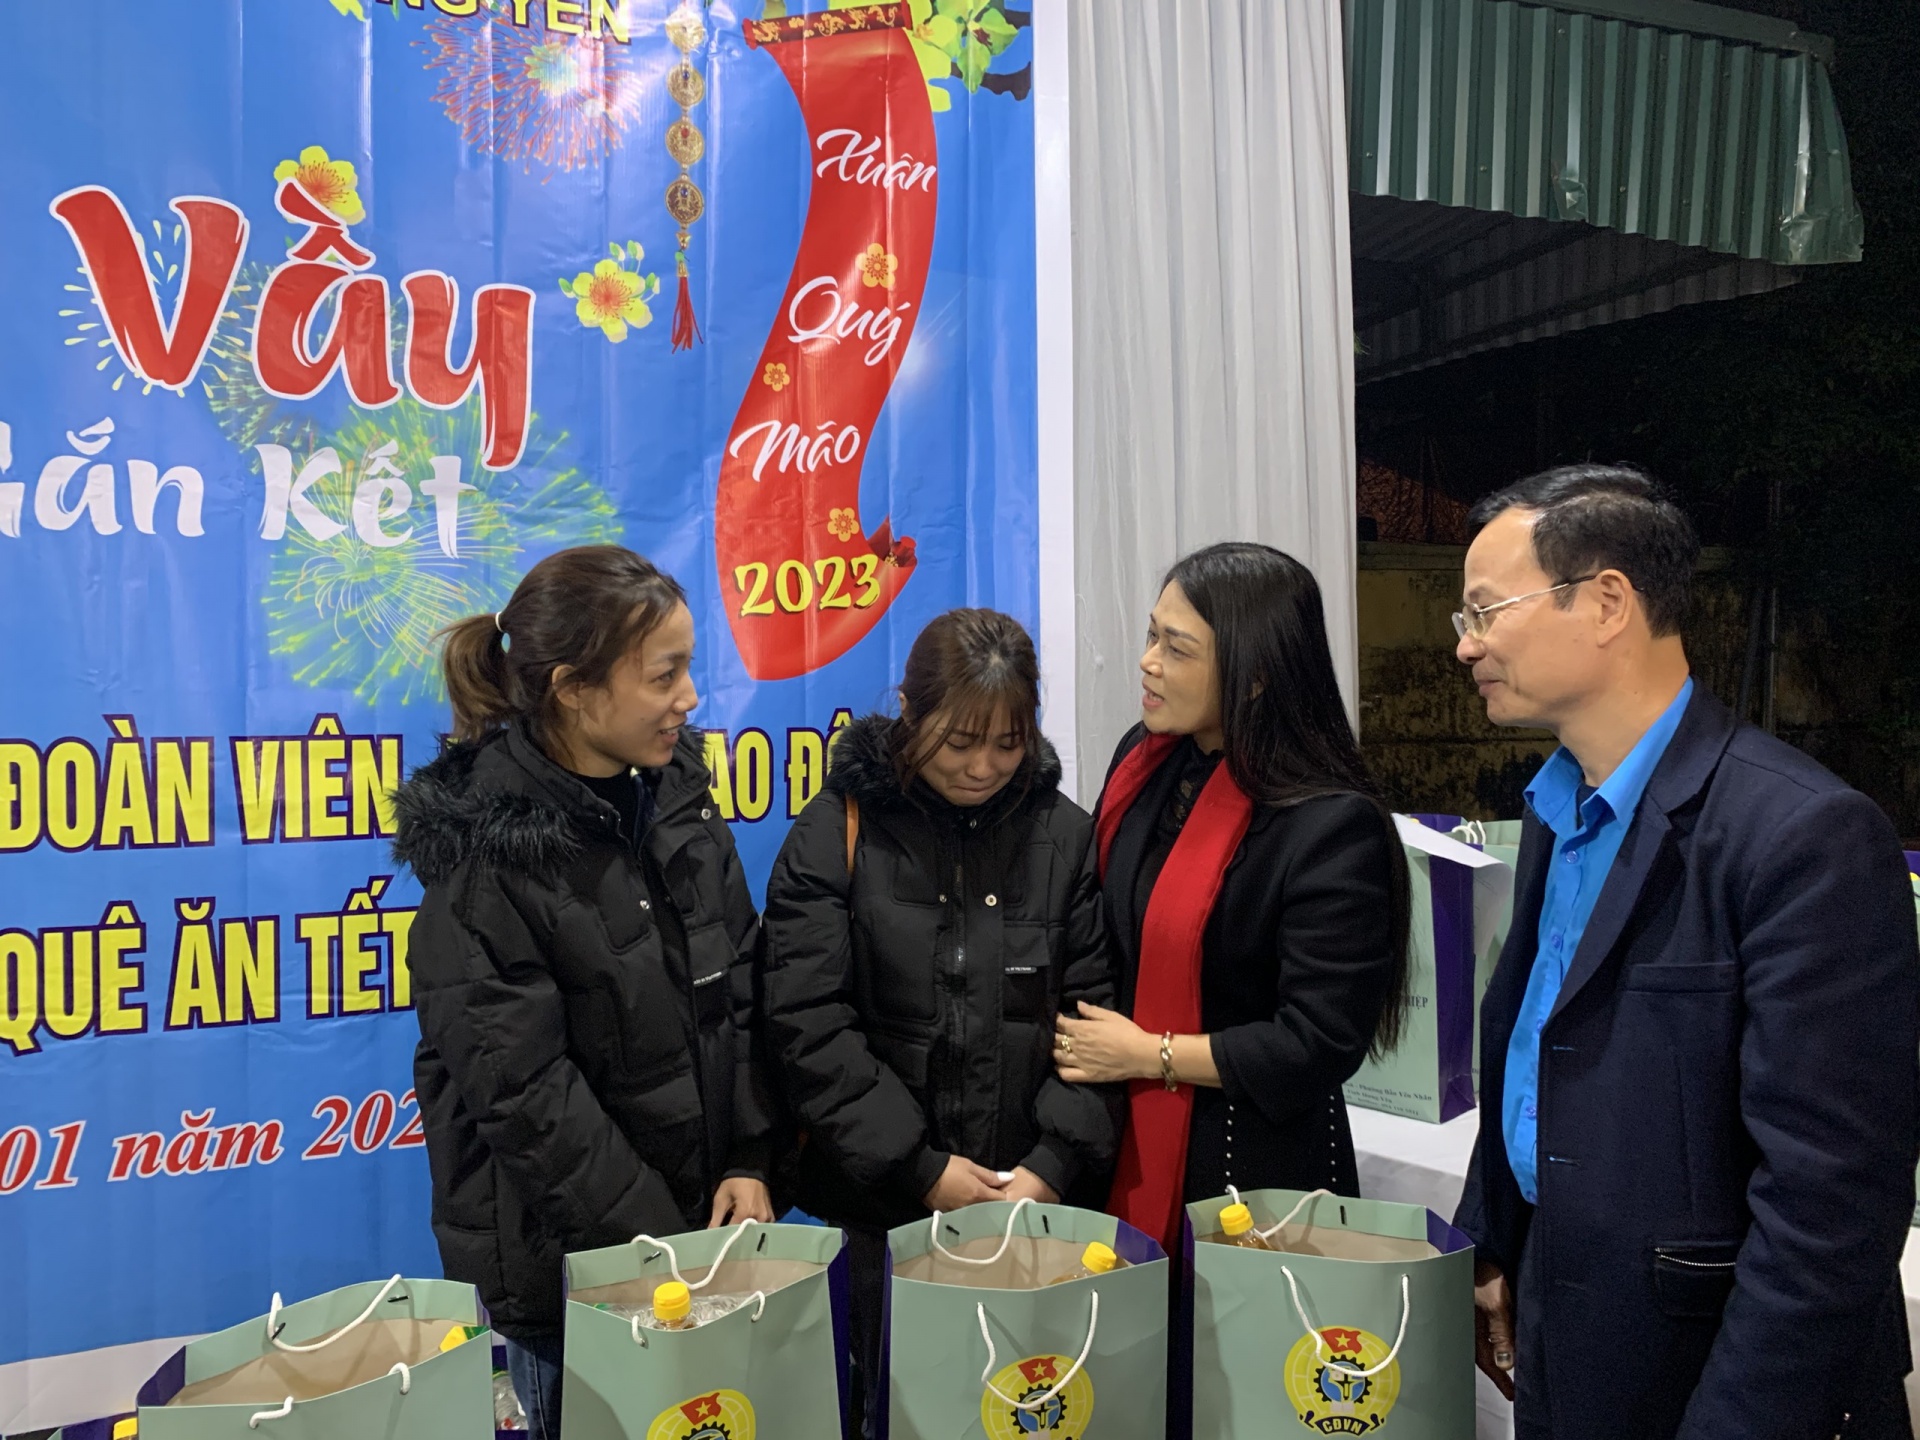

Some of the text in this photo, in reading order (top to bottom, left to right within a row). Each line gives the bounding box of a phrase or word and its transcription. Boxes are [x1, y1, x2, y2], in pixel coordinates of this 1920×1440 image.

[816, 128, 937, 192] Xuân
[49, 178, 536, 471] Vầy
[787, 275, 911, 366] Quý
[729, 419, 860, 482] Mão
[254, 439, 478, 560] Kết
[733, 555, 883, 618] 2023
[0, 713, 215, 853] ĐOÀN
[229, 712, 404, 845] VIÊN
[701, 727, 774, 823] AO
[0, 875, 420, 1057] QUÊ ĂN TẾT
[107, 1107, 284, 1182] năm
[302, 1086, 427, 1161] 202
